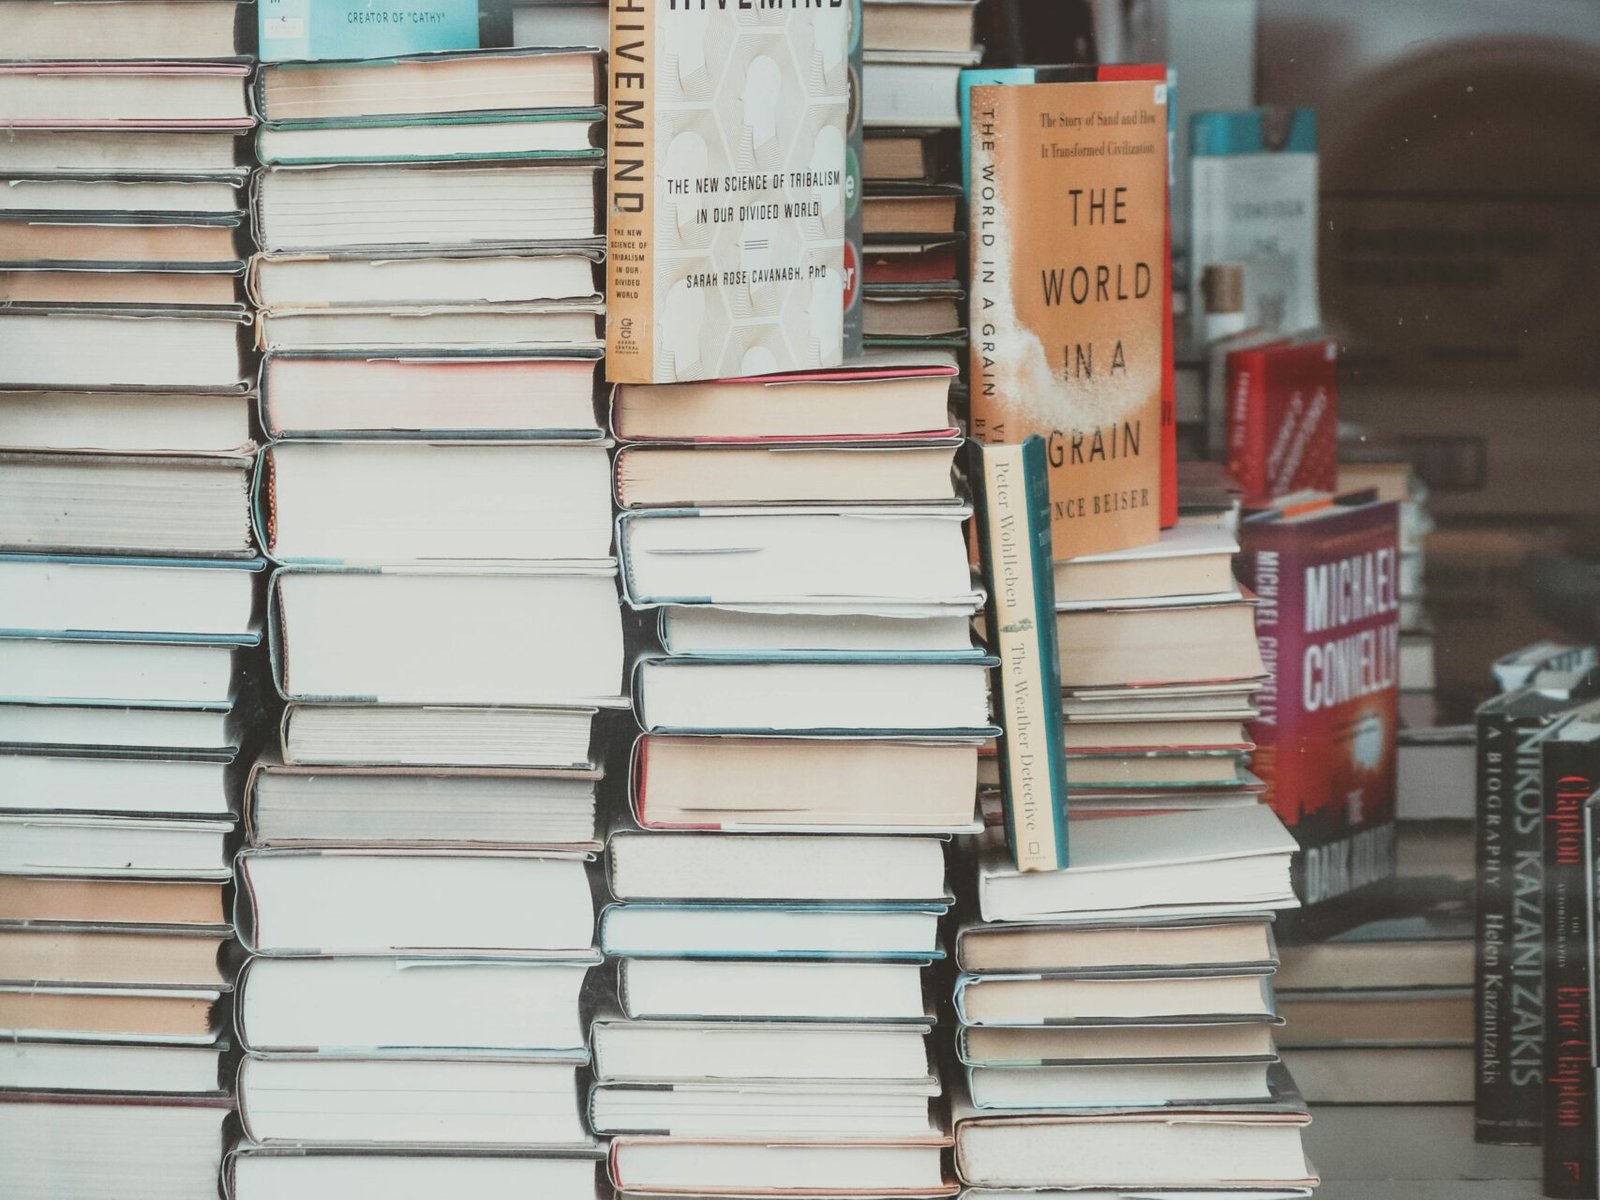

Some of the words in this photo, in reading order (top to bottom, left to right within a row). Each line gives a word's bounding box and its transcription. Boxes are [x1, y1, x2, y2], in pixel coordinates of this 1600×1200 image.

[347, 12, 389, 24] CREATOR
[392, 12, 404, 24] OF
[981, 107, 996, 152] THE
[1041, 112, 1057, 128] The
[1058, 111, 1082, 131] Story
[1085, 111, 1096, 127] of
[1097, 109, 1120, 126] Sand
[1121, 109, 1138, 125] and
[1041, 143, 1049, 159] It
[1050, 140, 1106, 158] Transformed
[668, 179, 690, 195] THE
[695, 177, 719, 194] NEW
[724, 174, 768, 192] SCIENCE
[772, 173, 785, 189] OF
[790, 170, 841, 188] TRIBALISM
[696, 208, 708, 225] IN
[713, 206, 734, 223] OUR
[739, 203, 779, 221] DIVIDED
[784, 201, 820, 218] WORLD
[981, 164, 996, 247] WORLD
[1068, 187, 1128, 227] THE
[610, 241, 635, 249] SCIENCE
[638, 241, 648, 249] OF
[613, 228, 624, 237] THE
[627, 229, 642, 237] NEW
[611, 253, 645, 261] TRIBALISM
[686, 272, 718, 289] SARAH
[723, 270, 747, 286] ROSE
[752, 266, 804, 284] CAVANAGH,
[808, 264, 827, 279] PhD
[982, 260, 995, 284] IN
[614, 279, 640, 287] DIVIDED
[616, 291, 639, 299] WORLD
[983, 297, 995, 310] A
[1041, 261, 1152, 307] WORLD
[982, 323, 996, 397] GRAIN
[1063, 342, 1093, 382] IN
[1110, 339, 1127, 377] A
[1048, 419, 1142, 469] GRAIN
[996, 462, 1011, 508] Peter
[1093, 488, 1150, 515] BEISER
[1001, 515, 1019, 608] Wohlleben
[1255, 550, 1280, 627] MICHAEL
[1305, 546, 1398, 634] MICHAEL
[1010, 642, 1026, 675] The
[1303, 623, 1398, 713] CONNELLY
[1013, 679, 1032, 750] Weather
[1487, 726, 1503, 739] A
[1019, 752, 1039, 832] Detective
[1513, 726, 1544, 834] NIKOS
[1484, 751, 1504, 887] BIOGRAPHY
[1546, 775, 1591, 864] Clapton
[1484, 914, 1505, 968] Helen
[1482, 974, 1504, 1085] Kazantzakis
[1557, 986, 1592, 1033] Eric
[1548, 1039, 1591, 1127] Clapton
